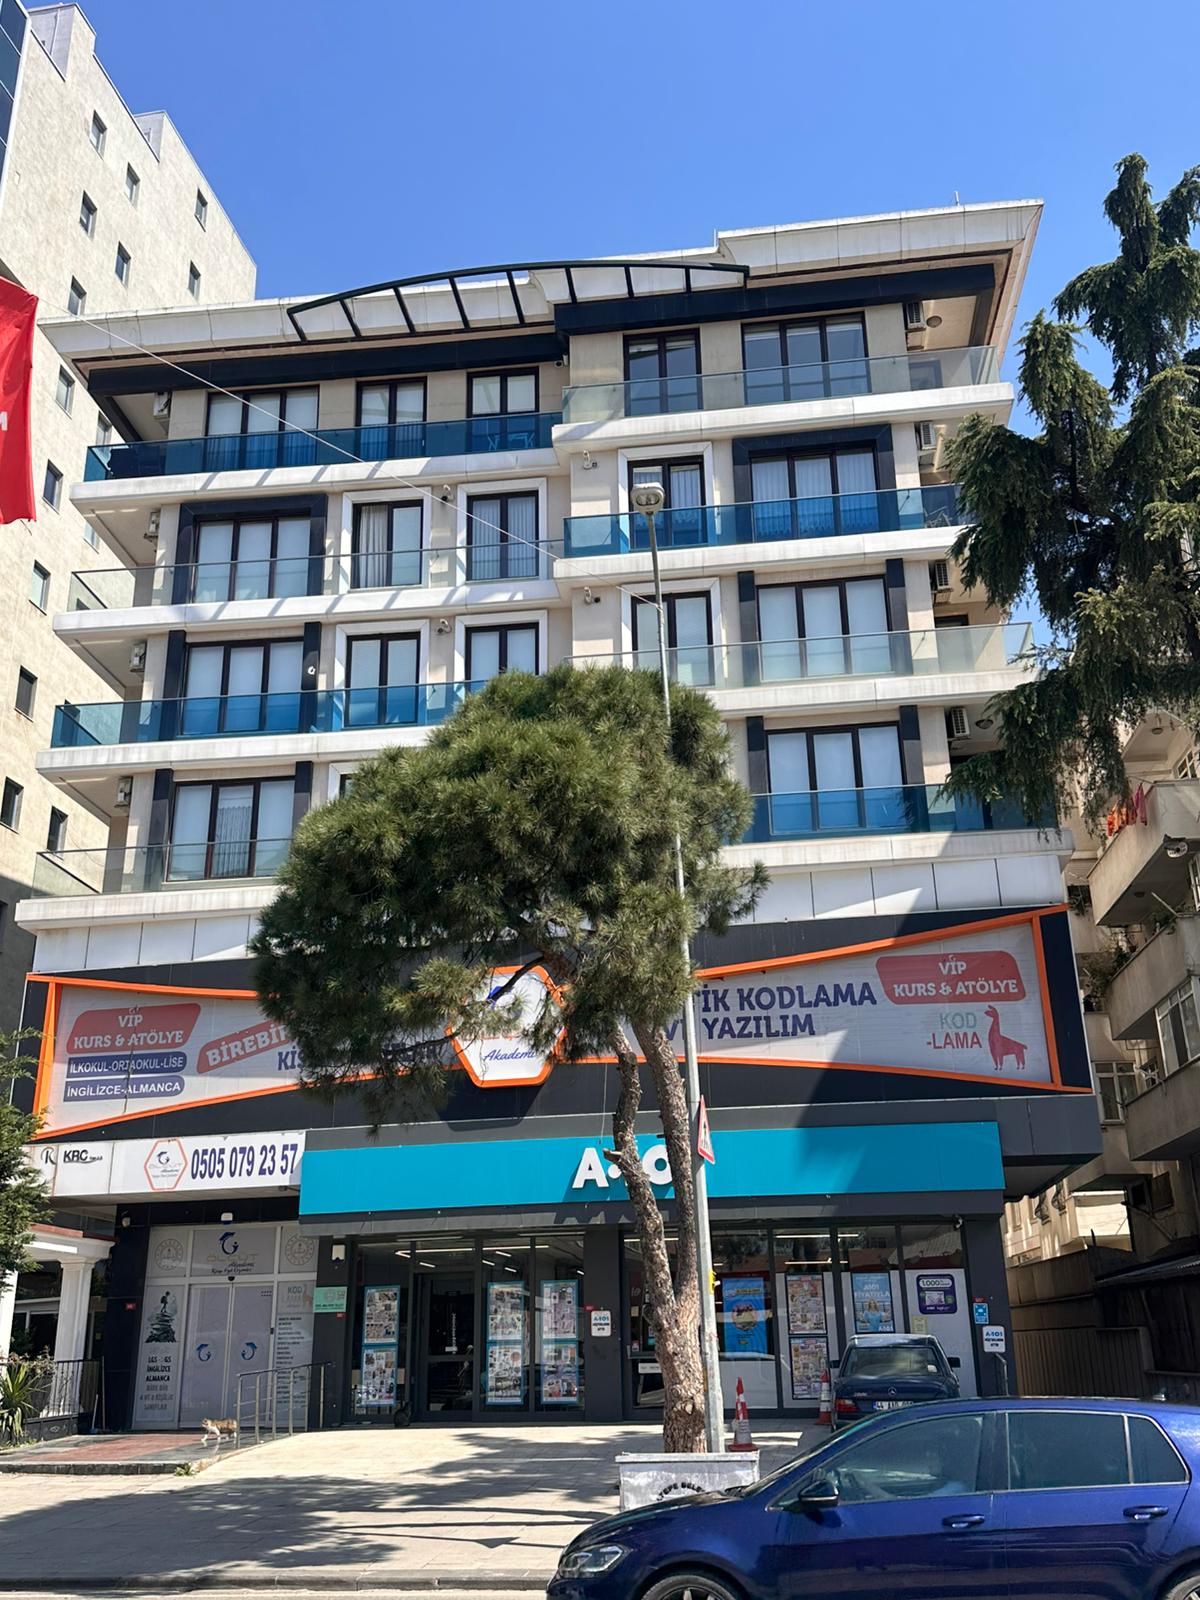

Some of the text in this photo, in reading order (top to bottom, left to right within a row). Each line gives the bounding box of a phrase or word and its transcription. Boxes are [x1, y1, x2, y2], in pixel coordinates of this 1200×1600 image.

[938, 956, 967, 976] VİP
[738, 983, 877, 1010] KODLAMA
[893, 976, 1018, 998] KURS & ATÖLYE
[118, 1011, 143, 1028] VİP
[702, 1013, 816, 1040] YAZILIM
[939, 1012, 977, 1029] KOD
[74, 1028, 183, 1050] KURS & ATÖLYE
[926, 1031, 982, 1050] -LAMA
[483, 1047, 537, 1062] Akademi
[69, 1055, 184, 1074] İLKOKUL-ORTAOKUL-LİSE
[66, 1080, 181, 1098] İNGİLİZCE-ALMANCA
[63, 1149, 89, 1164] KRC
[191, 1143, 298, 1180] 0505 079 23 57
